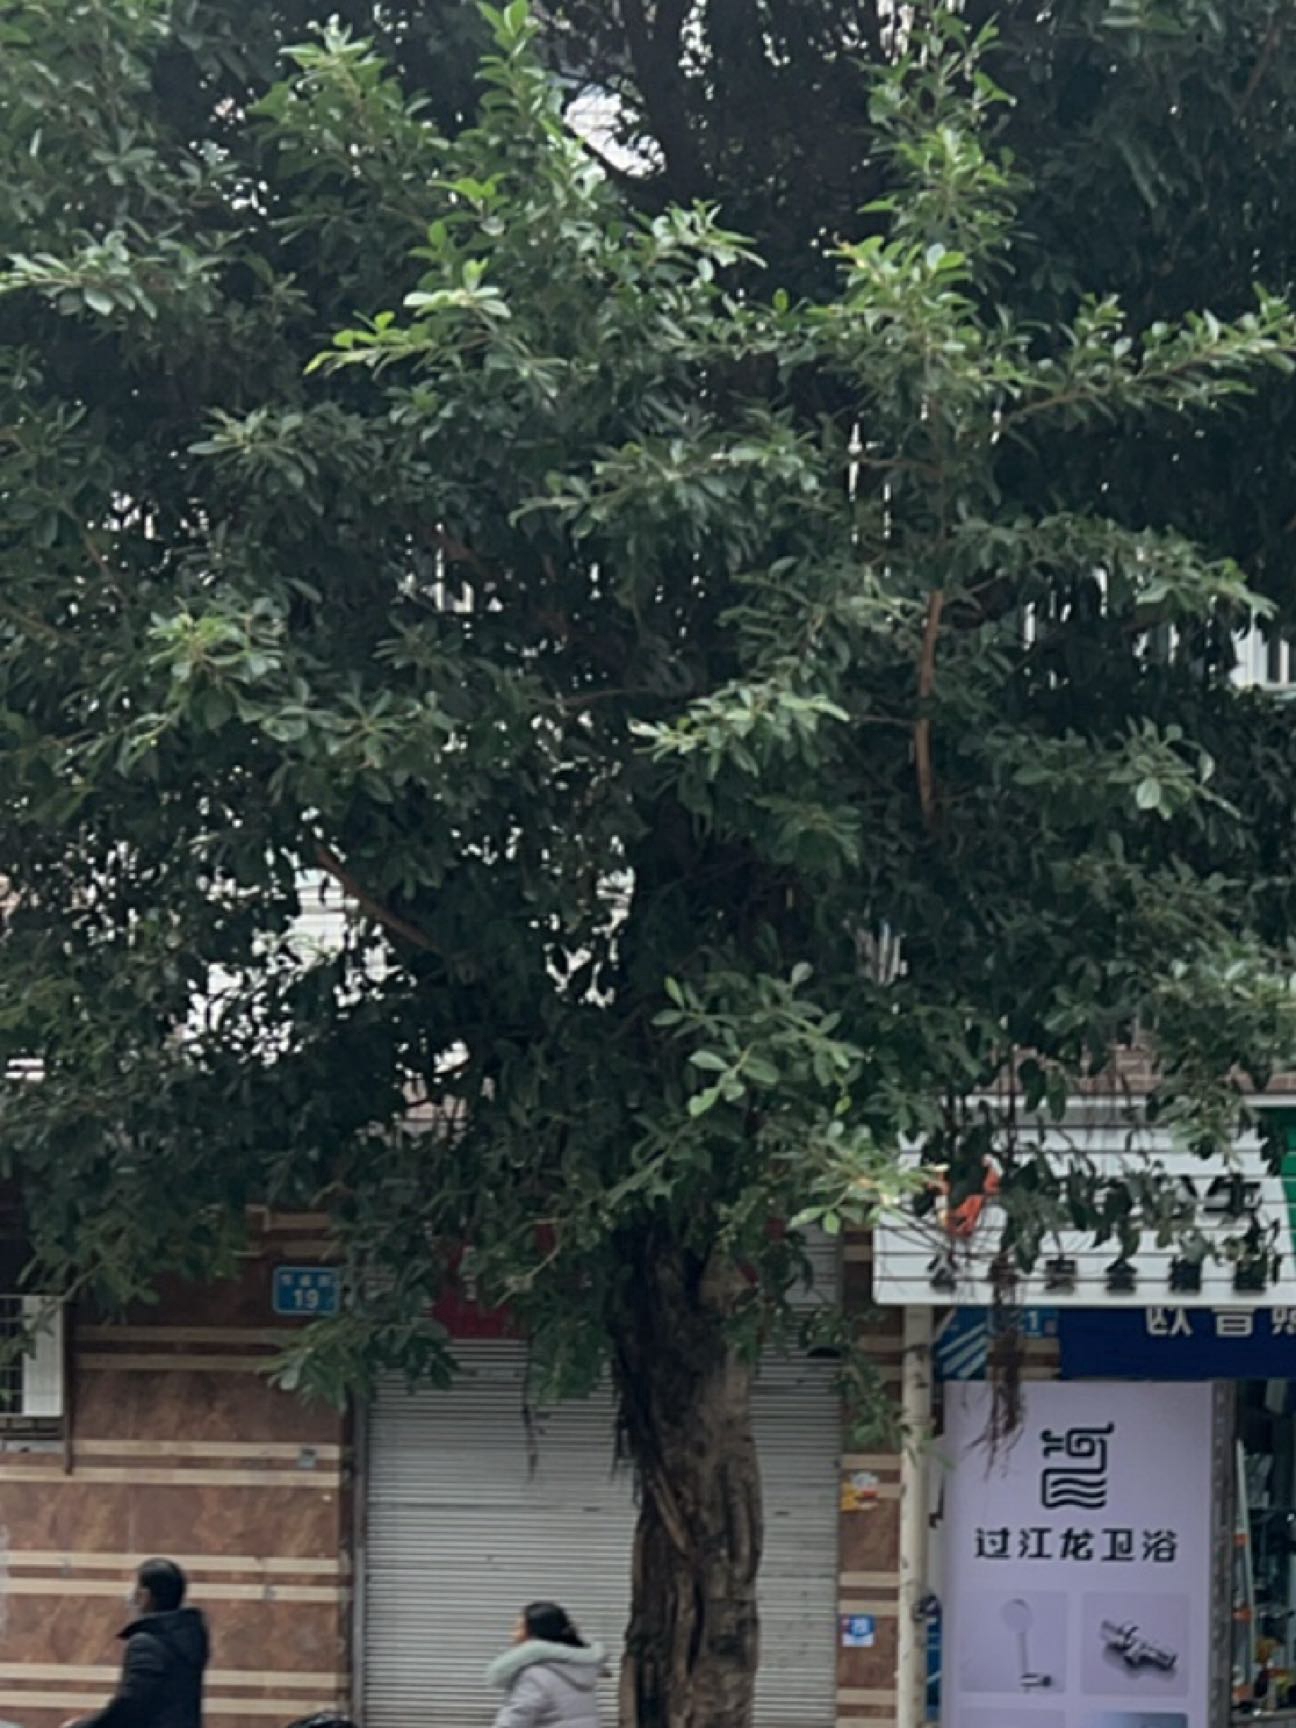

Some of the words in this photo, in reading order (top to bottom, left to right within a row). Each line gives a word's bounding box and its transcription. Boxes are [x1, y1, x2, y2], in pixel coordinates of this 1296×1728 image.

[293, 1289, 319, 1309] 19
[975, 1527, 1177, 1562] 过江龙卫浴
